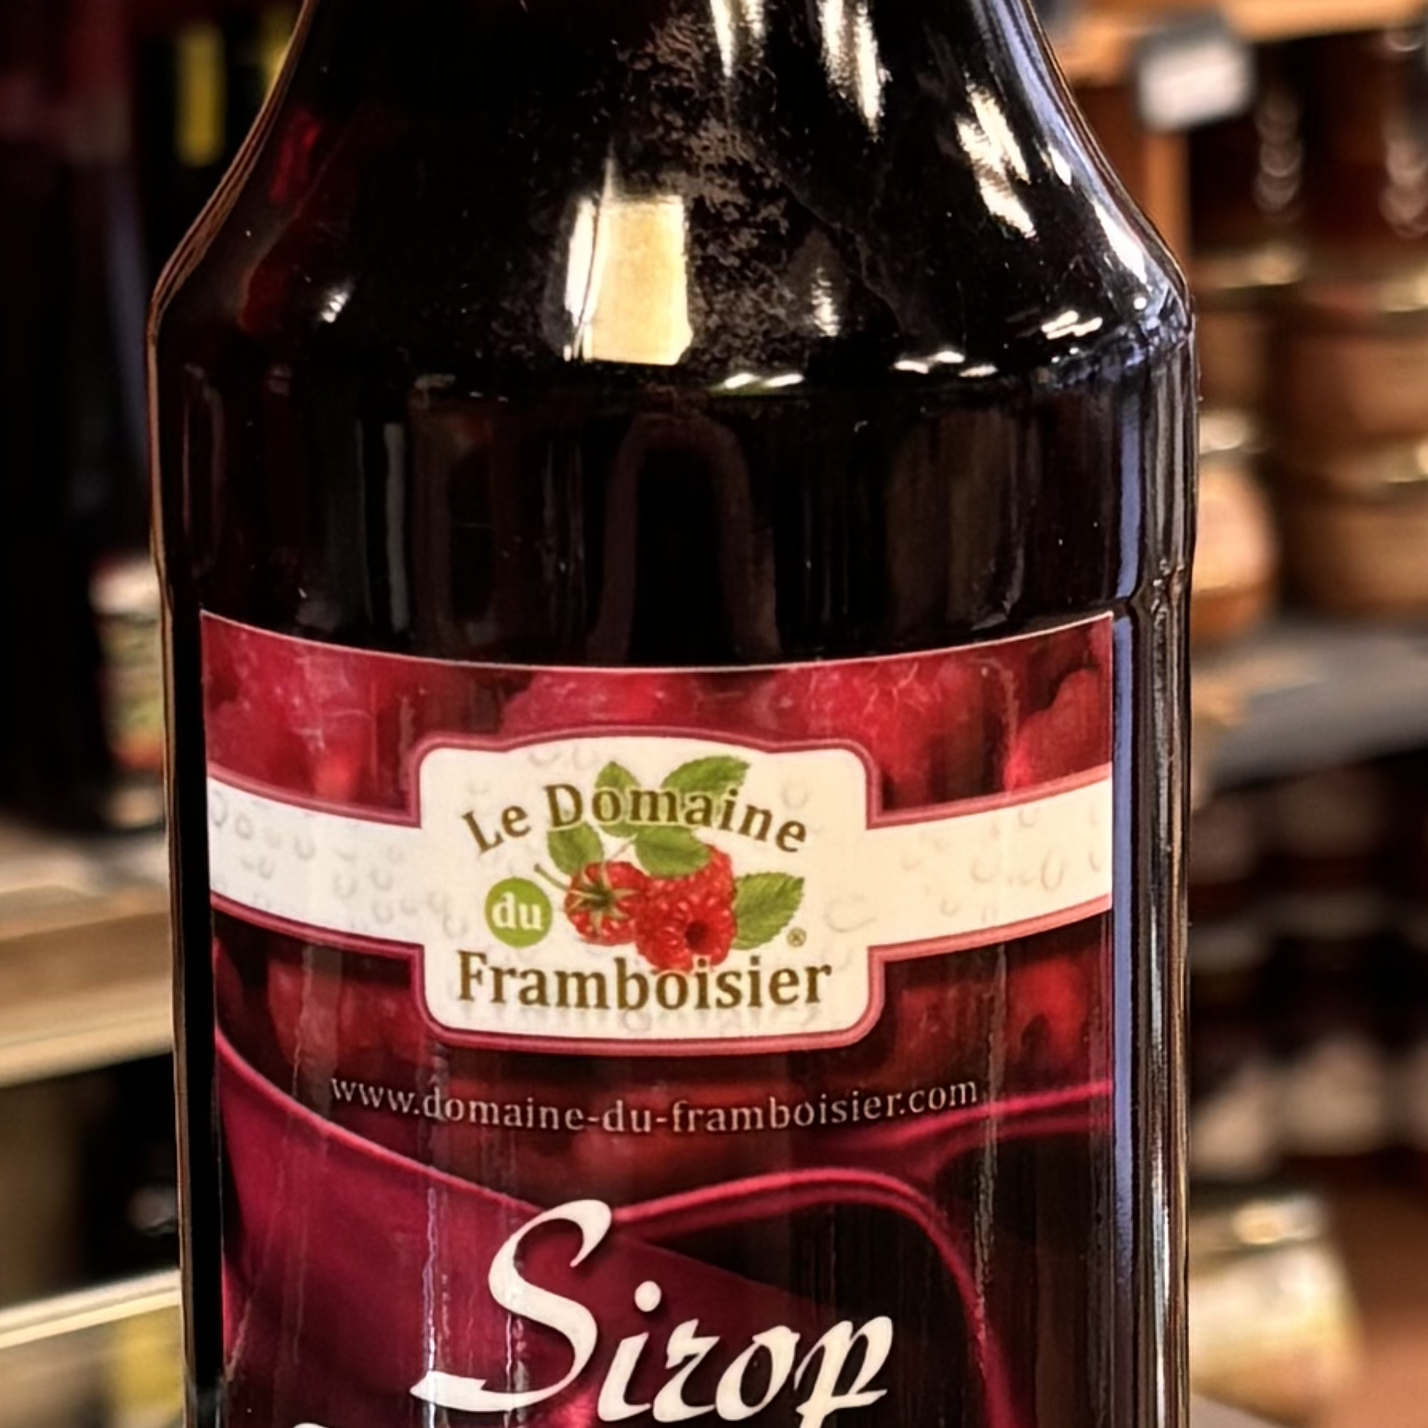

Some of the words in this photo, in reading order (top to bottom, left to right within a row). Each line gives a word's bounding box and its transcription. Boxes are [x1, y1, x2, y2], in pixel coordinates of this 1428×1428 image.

[462, 803, 530, 854] Le
[545, 783, 807, 853] Domaine
[492, 892, 542, 933] du
[459, 950, 832, 1010] Framboisier
[331, 1076, 977, 1133] www.domaine-du-framboisier.com
